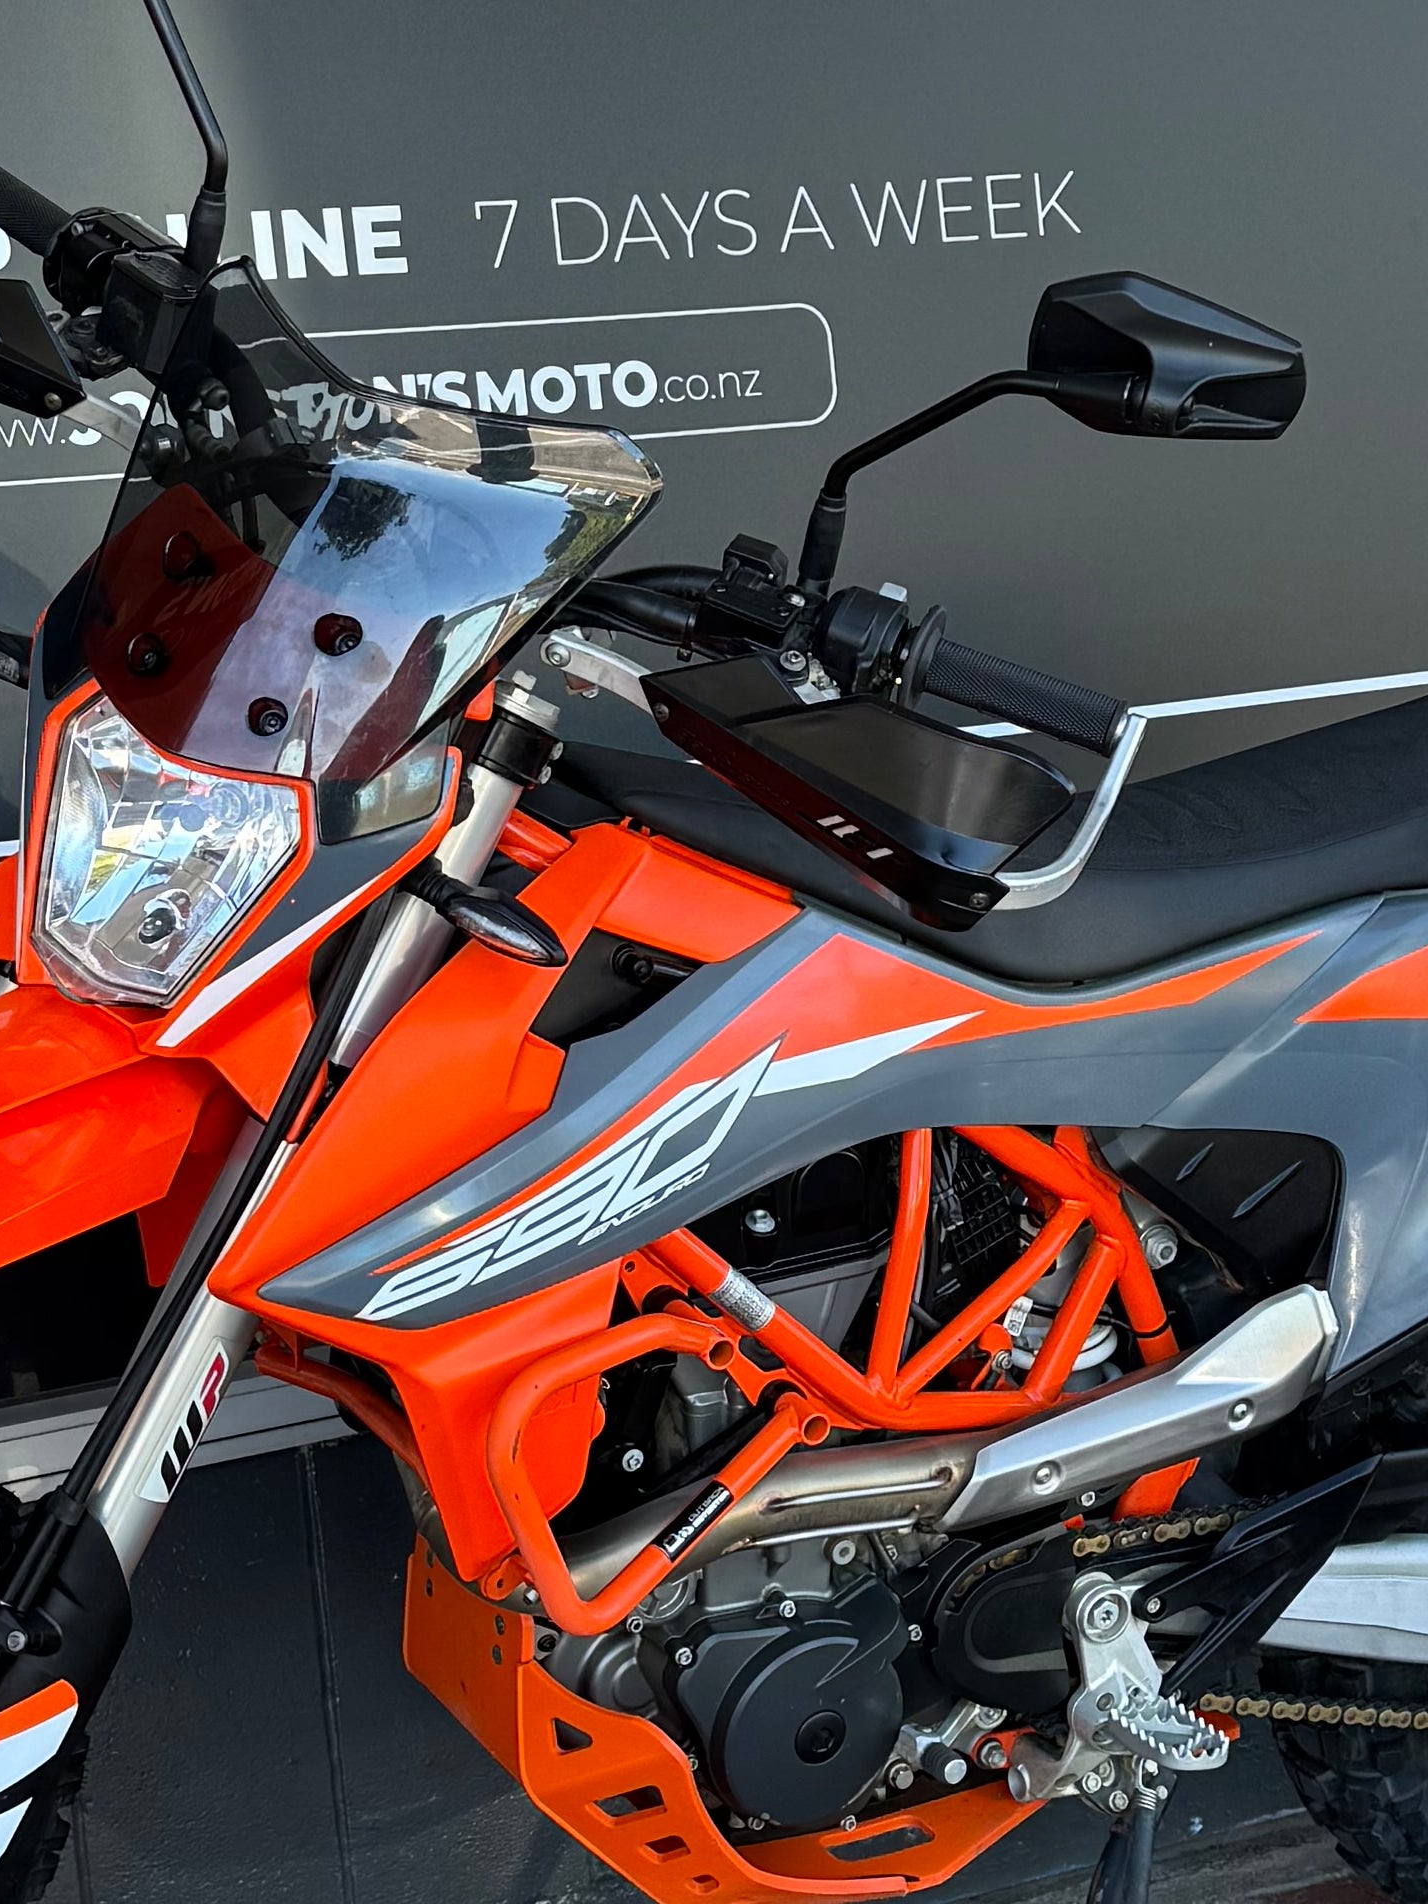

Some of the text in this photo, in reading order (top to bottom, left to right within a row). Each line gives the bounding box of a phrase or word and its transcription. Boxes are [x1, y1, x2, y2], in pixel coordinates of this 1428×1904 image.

[474, 198, 518, 269] 7
[550, 188, 758, 266] DAYS
[780, 185, 835, 253] A
[849, 169, 1082, 248] WEEK
